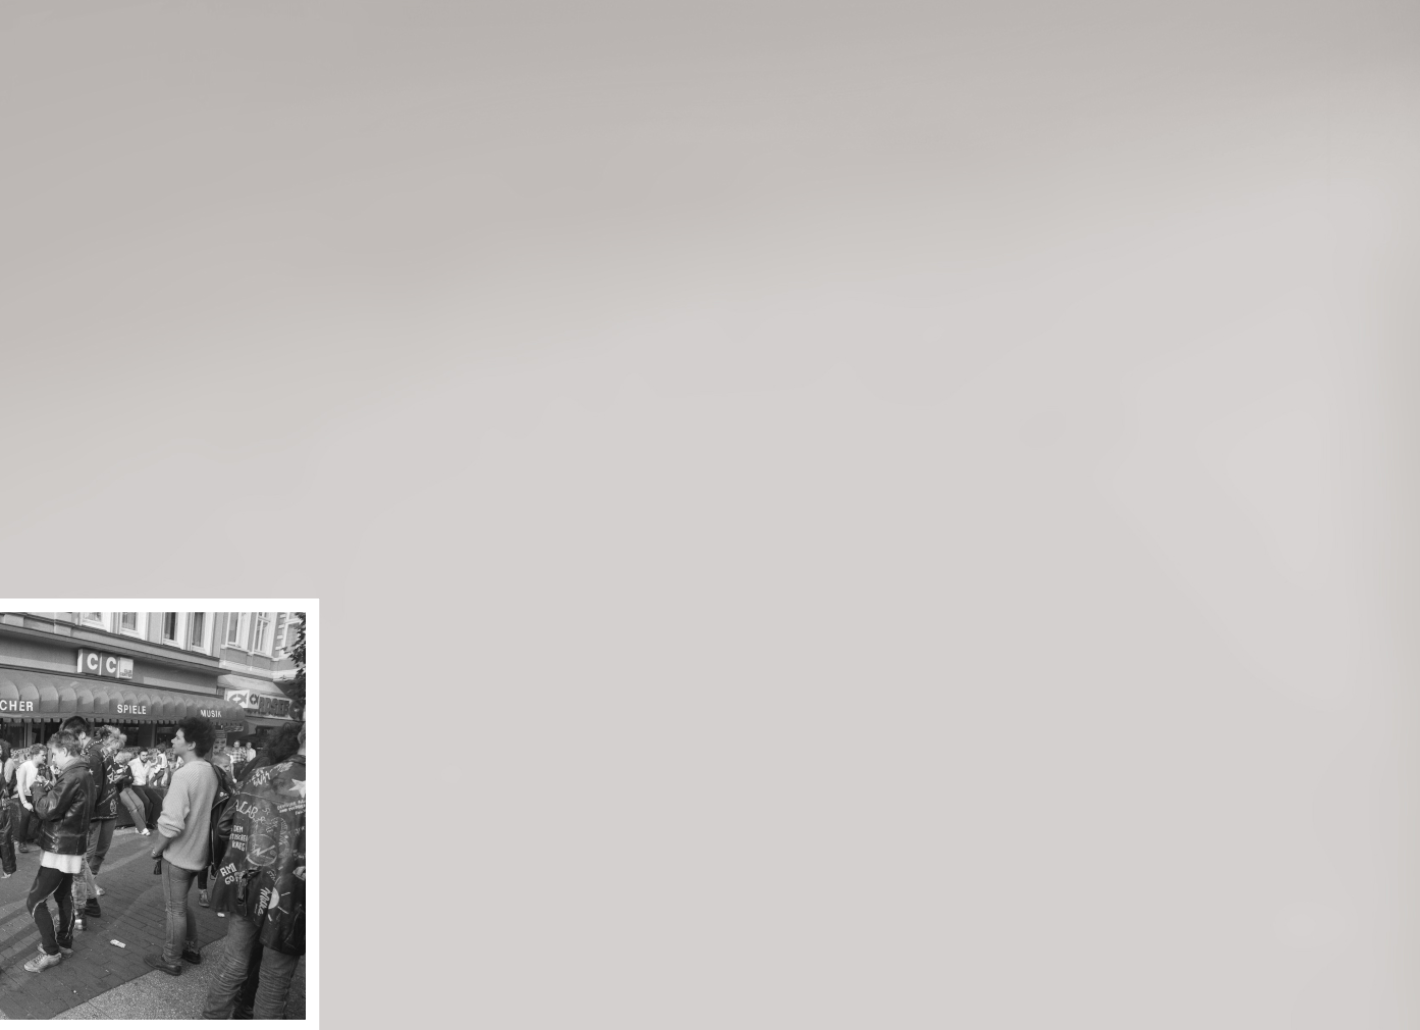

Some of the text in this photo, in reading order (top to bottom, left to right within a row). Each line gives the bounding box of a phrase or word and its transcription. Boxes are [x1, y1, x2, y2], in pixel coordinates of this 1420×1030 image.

[117, 704, 147, 715] SPIELE
[200, 709, 222, 718] MUSIK
[220, 863, 237, 877] AMI
